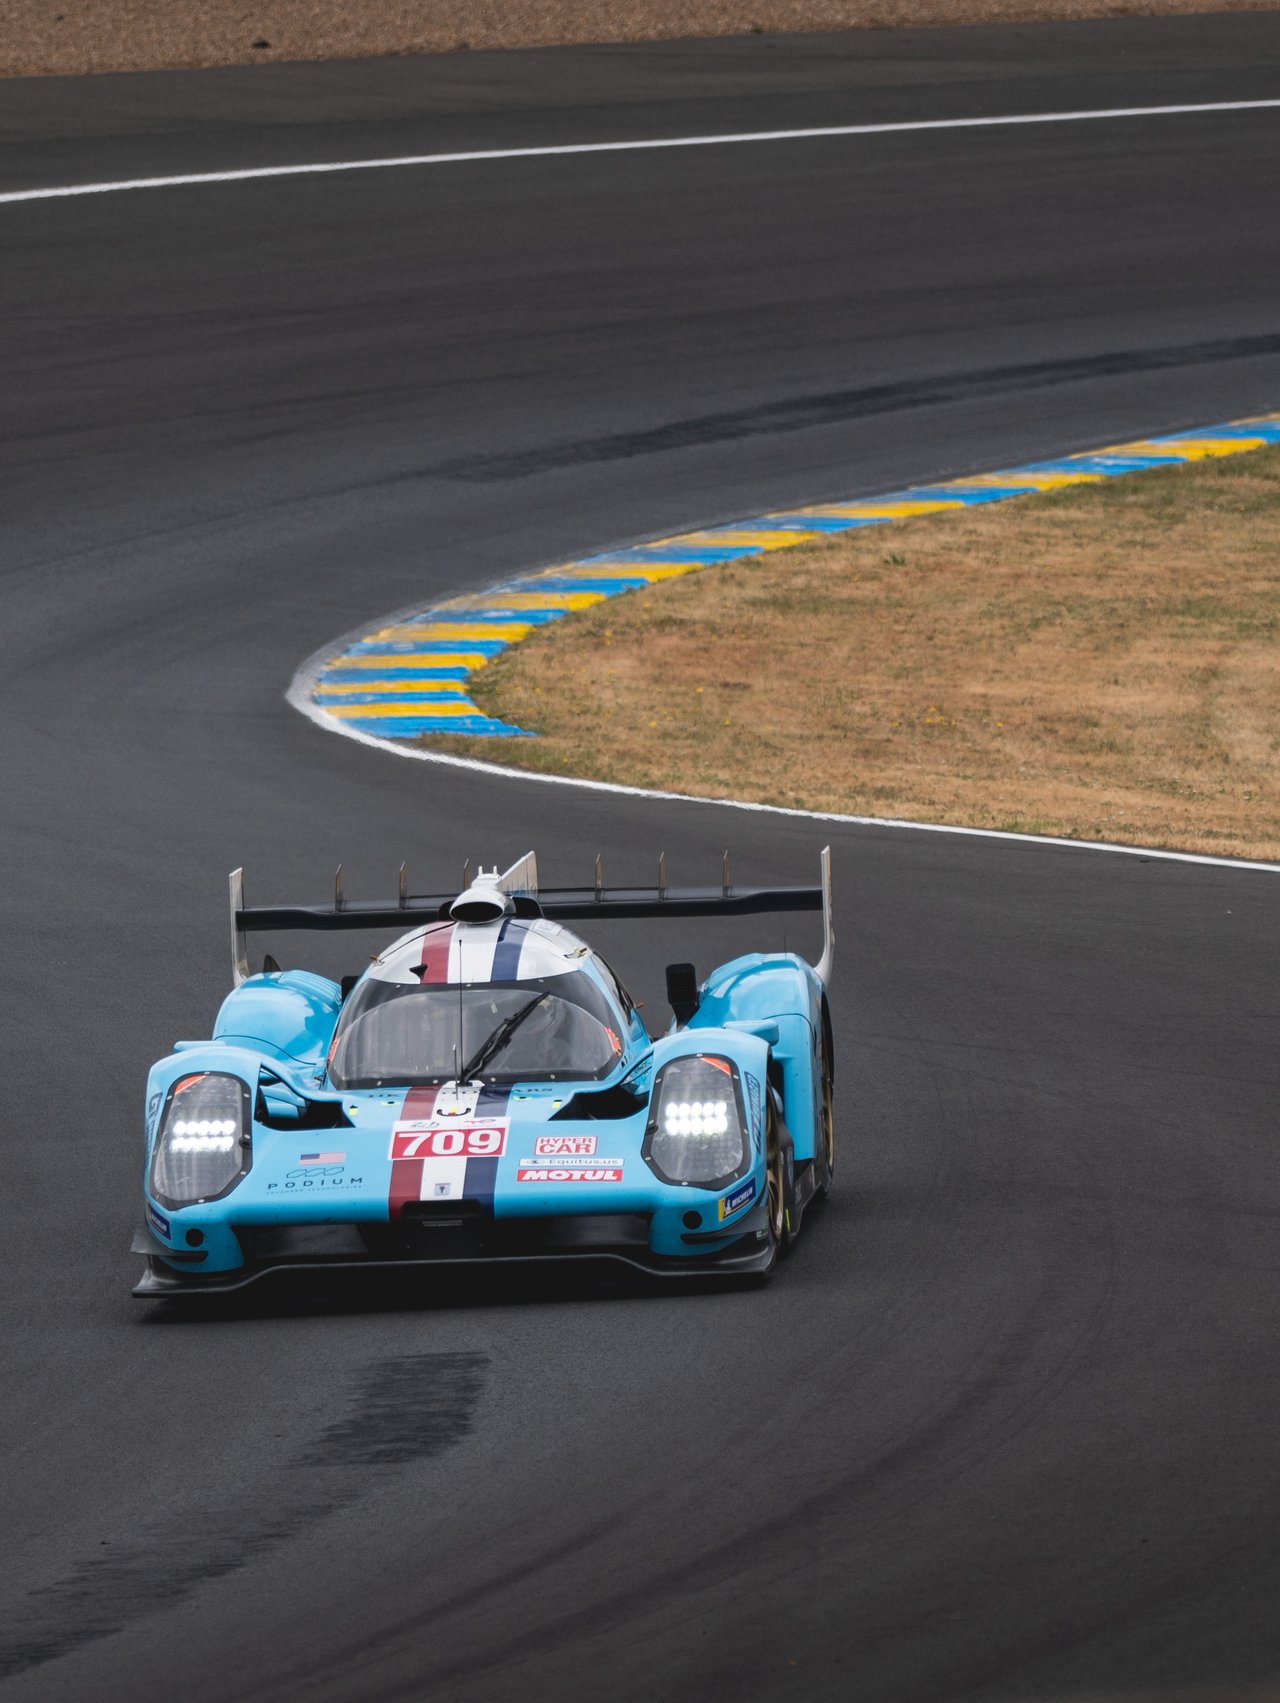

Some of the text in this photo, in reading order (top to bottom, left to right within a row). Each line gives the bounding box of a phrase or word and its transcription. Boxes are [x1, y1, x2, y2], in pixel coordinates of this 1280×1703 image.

[398, 1129, 502, 1157] 709
[540, 1137, 593, 1145] HYPER
[539, 1144, 592, 1154] CAR
[521, 1170, 618, 1180] MOTUL
[267, 1177, 363, 1190] PODIUM
[731, 1186, 754, 1208] MICHELIN
